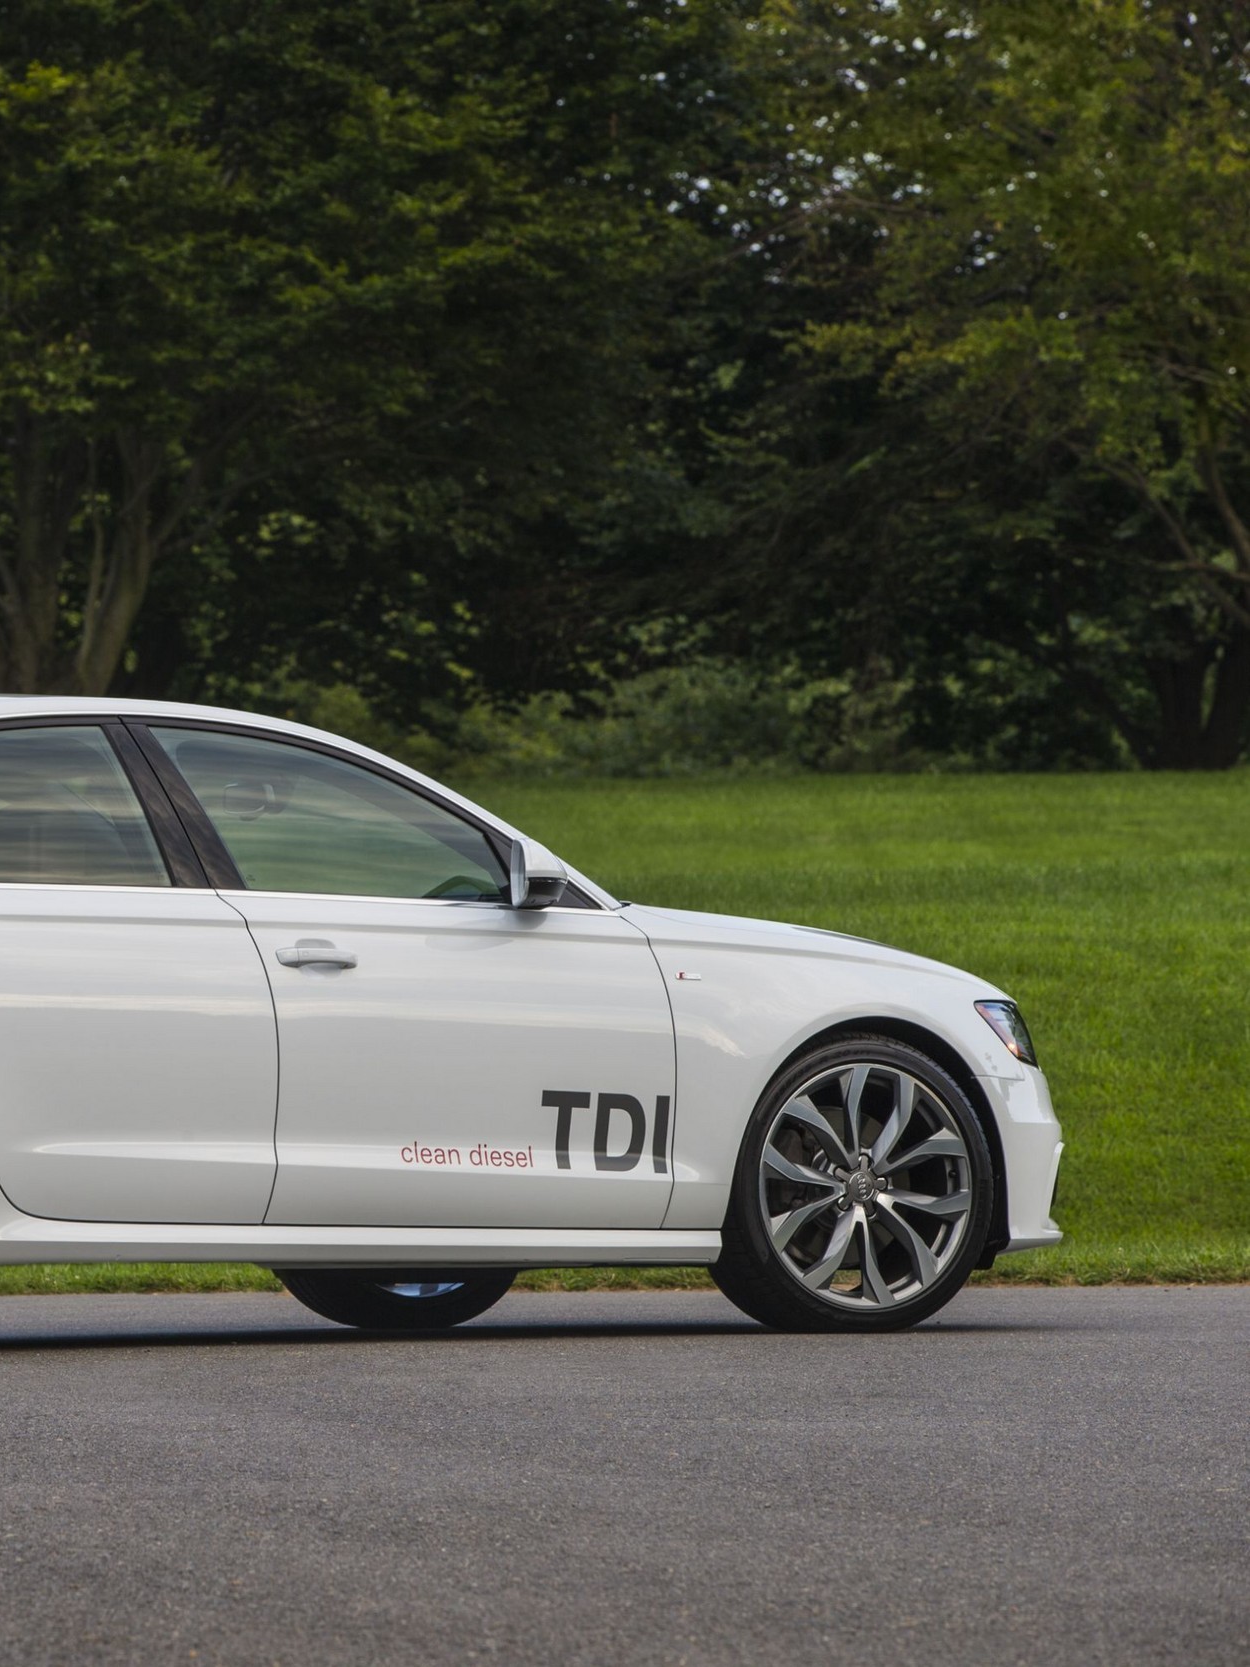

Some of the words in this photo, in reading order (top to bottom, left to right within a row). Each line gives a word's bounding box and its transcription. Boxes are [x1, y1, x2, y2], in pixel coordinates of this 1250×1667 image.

[400, 1141, 461, 1165] clean
[469, 1143, 534, 1168] diesel
[541, 1089, 670, 1174] TDI
